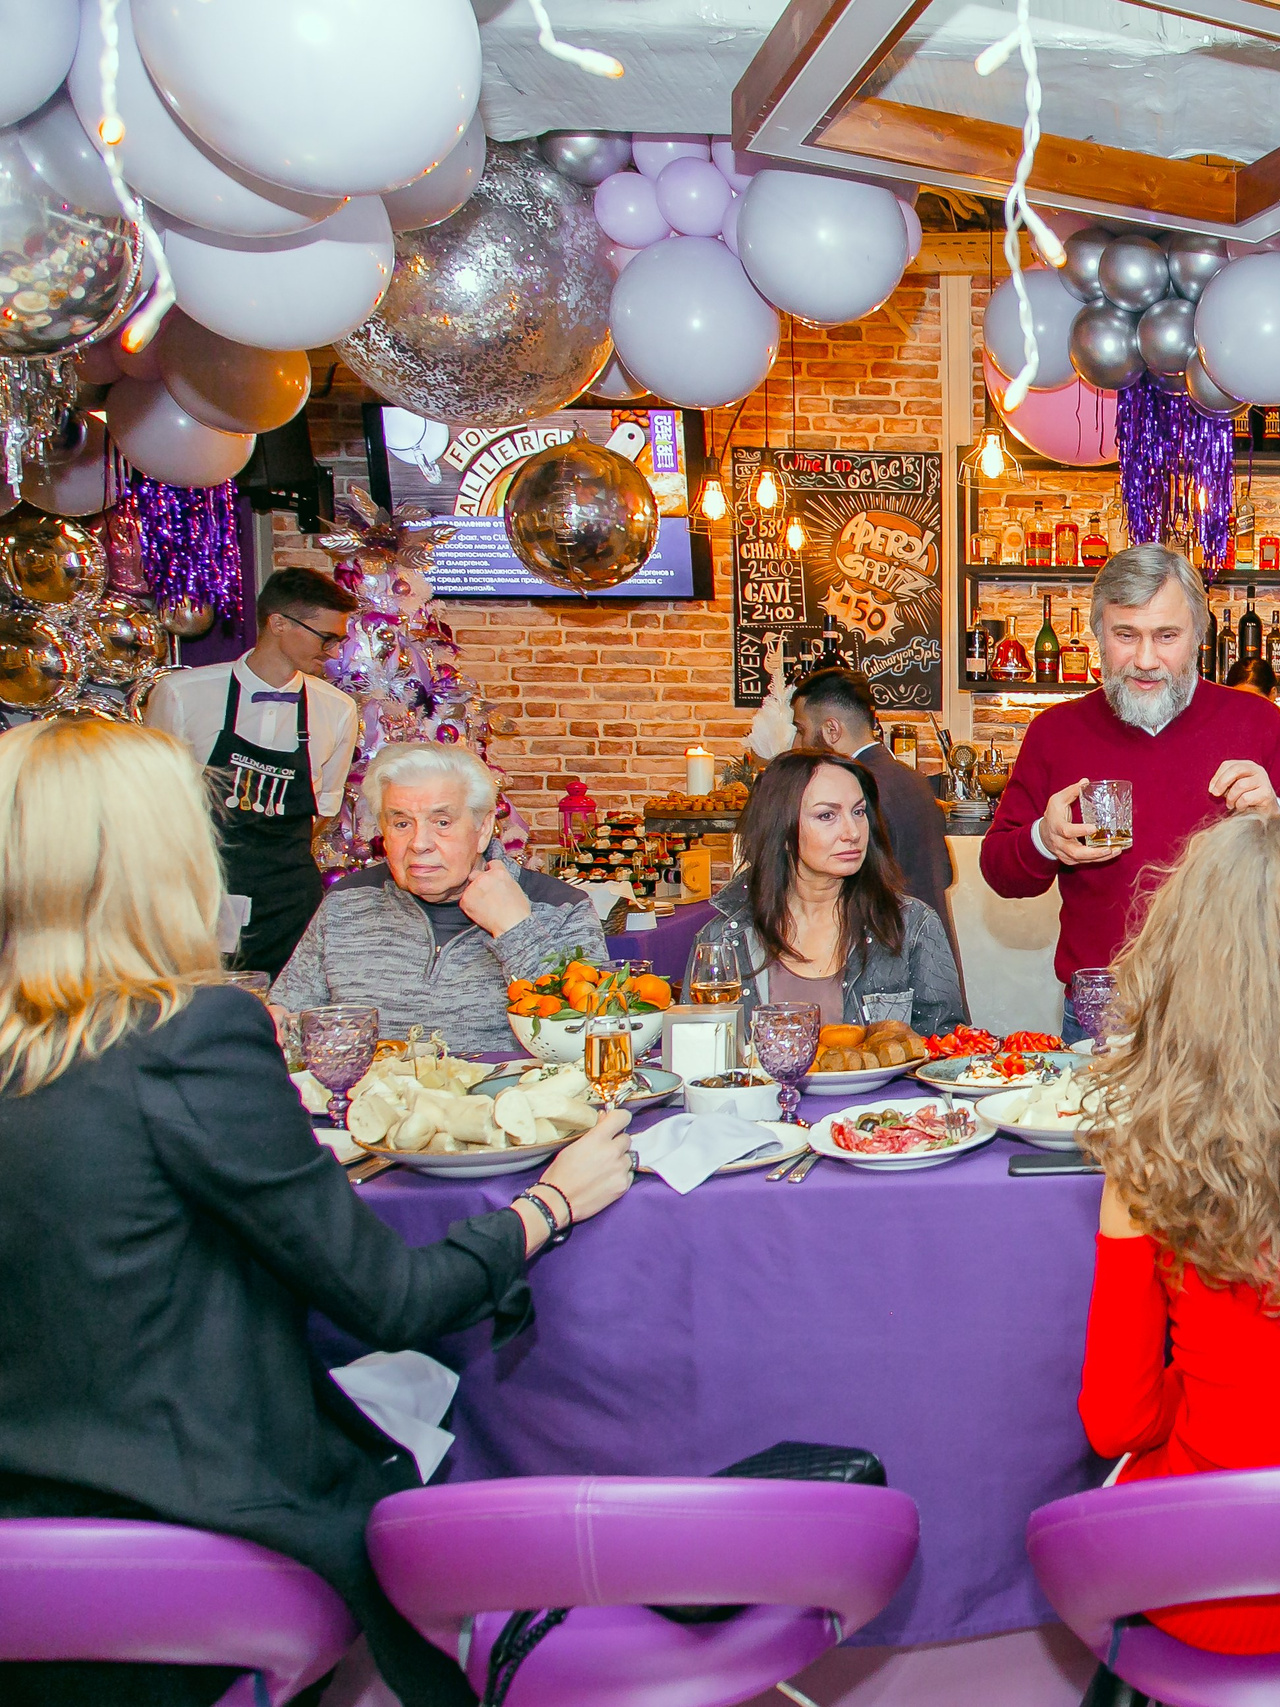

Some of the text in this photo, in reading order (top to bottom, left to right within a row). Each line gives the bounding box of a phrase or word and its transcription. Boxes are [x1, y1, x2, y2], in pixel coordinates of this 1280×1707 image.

[779, 454, 823, 472] Wine
[752, 604, 795, 622] 2400
[741, 632, 763, 695] EVERY
